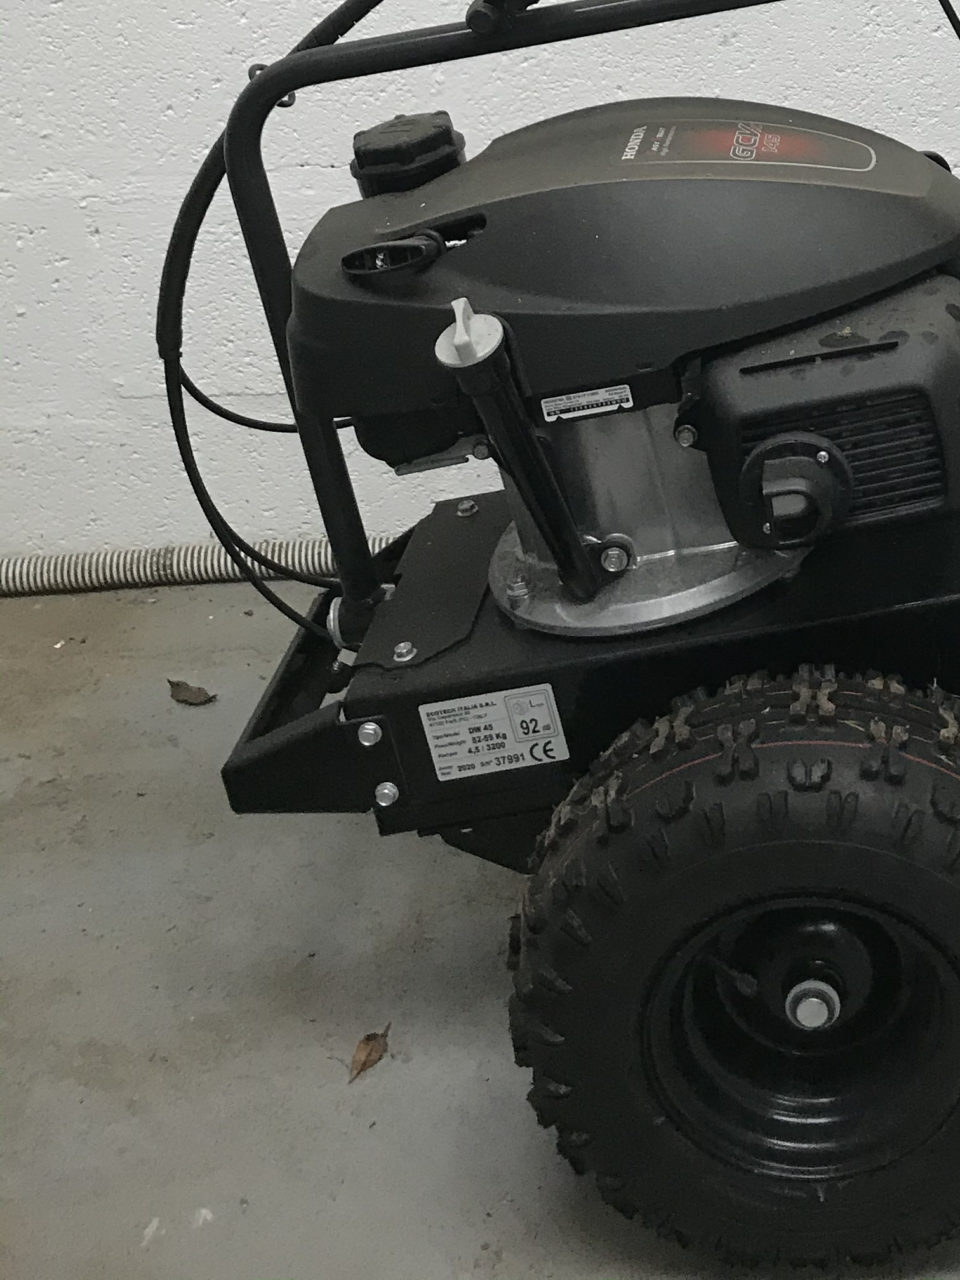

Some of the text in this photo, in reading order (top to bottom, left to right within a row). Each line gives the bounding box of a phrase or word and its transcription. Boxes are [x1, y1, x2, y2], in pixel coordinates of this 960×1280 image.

[621, 125, 648, 160] HONDA
[457, 703, 478, 712] ITALIA
[520, 717, 541, 736] 92
[495, 732, 508, 741] Kg
[486, 741, 506, 752] 3200
[494, 752, 525, 766] 37991
